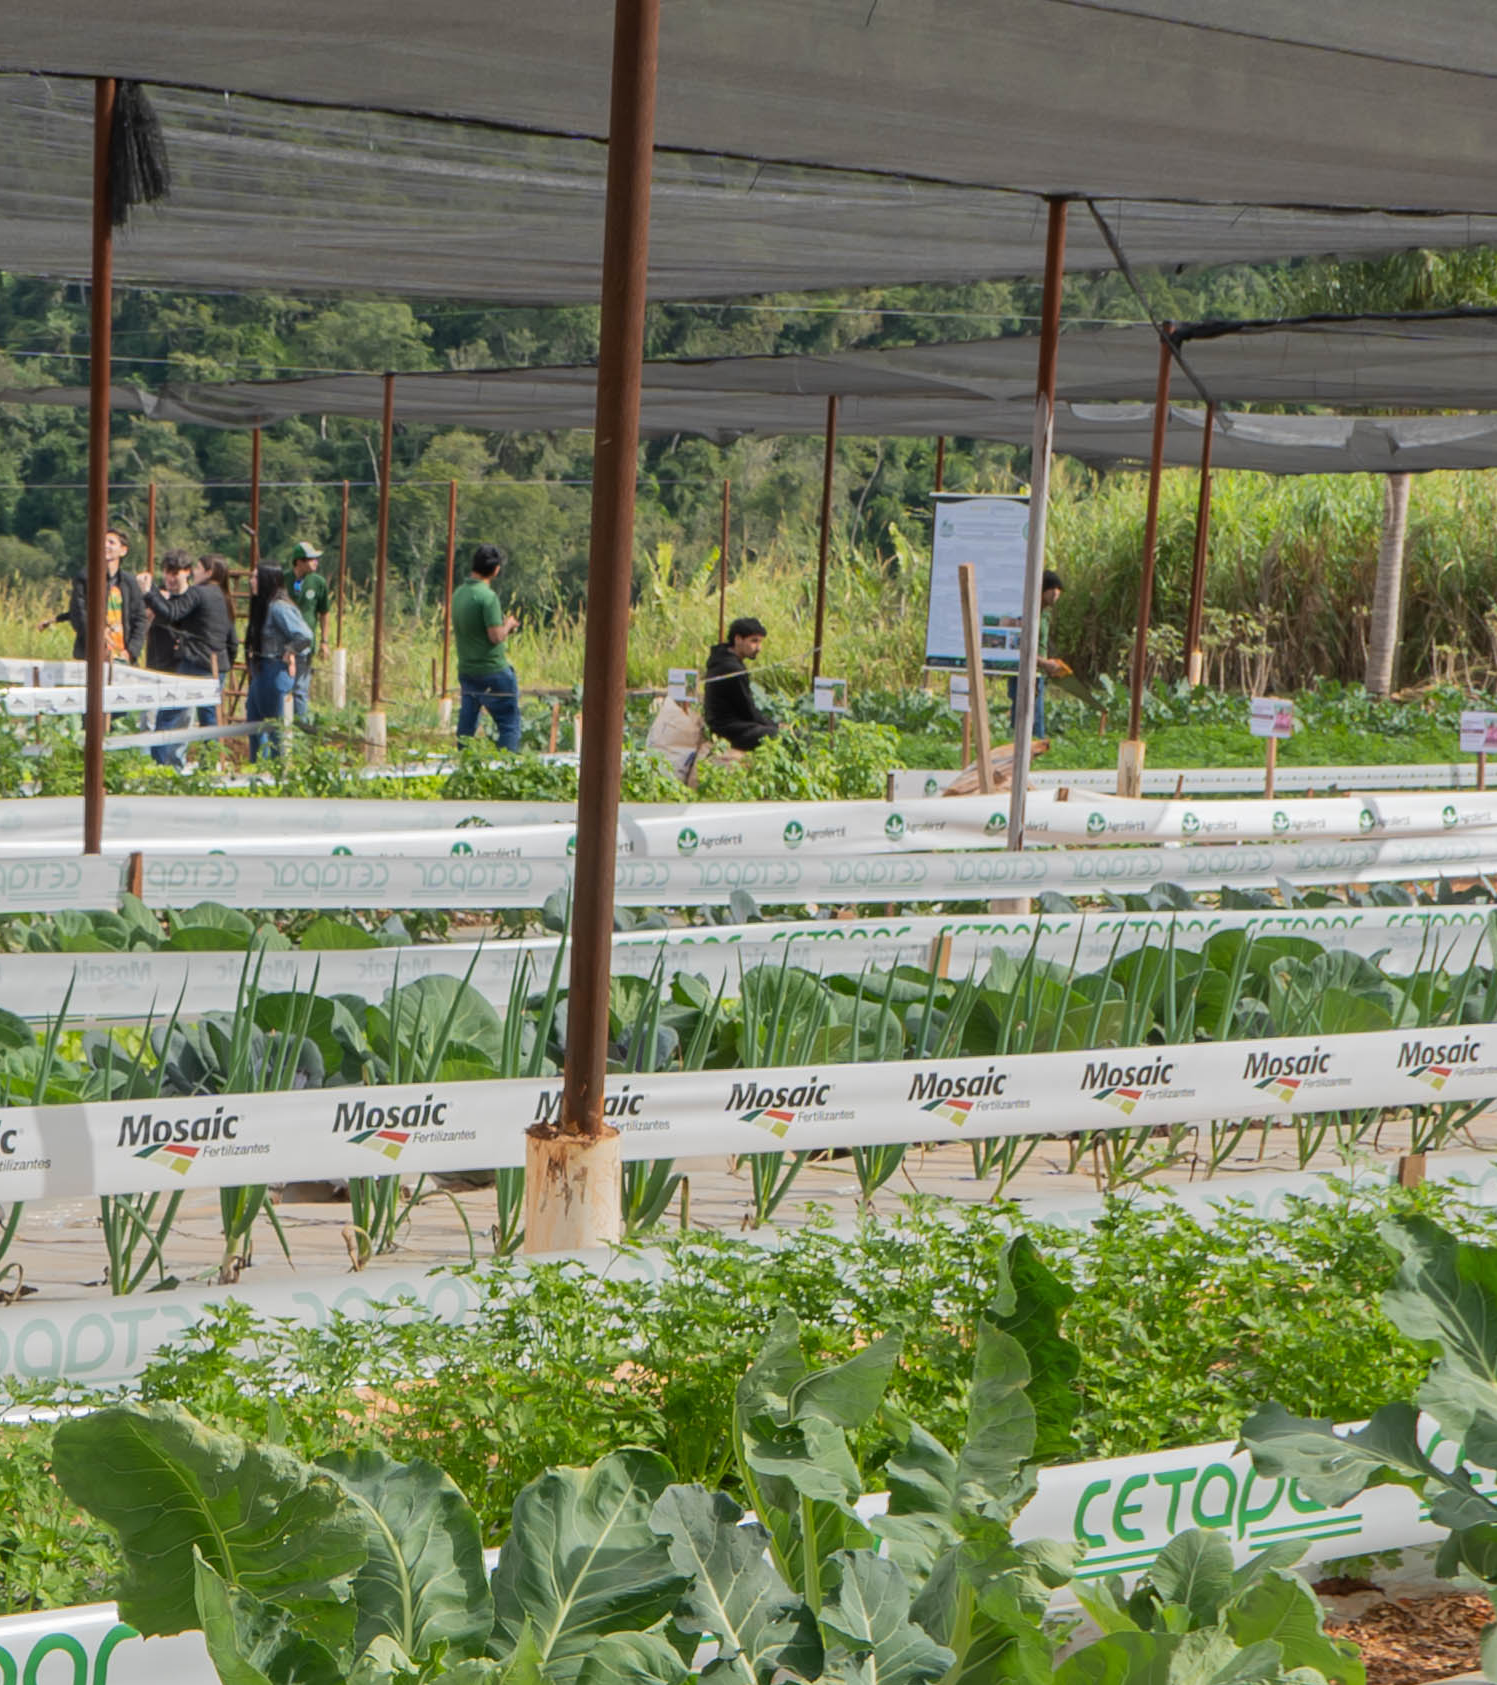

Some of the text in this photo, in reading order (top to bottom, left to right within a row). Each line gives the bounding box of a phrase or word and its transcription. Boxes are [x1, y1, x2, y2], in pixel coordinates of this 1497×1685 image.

[1242, 1046, 1333, 1079] Mosaic
[1397, 1035, 1481, 1069] Mosaic
[908, 1066, 1007, 1101] Mosaic
[1080, 1056, 1174, 1090] Mosaic
[332, 1094, 448, 1134] Mosaic
[534, 1085, 645, 1121] Maic
[725, 1082, 831, 1112] Mosaic
[117, 1108, 239, 1148] Mosaic
[411, 1128, 478, 1145] Fertilizantes
[201, 1141, 272, 1160] Fertilizantes
